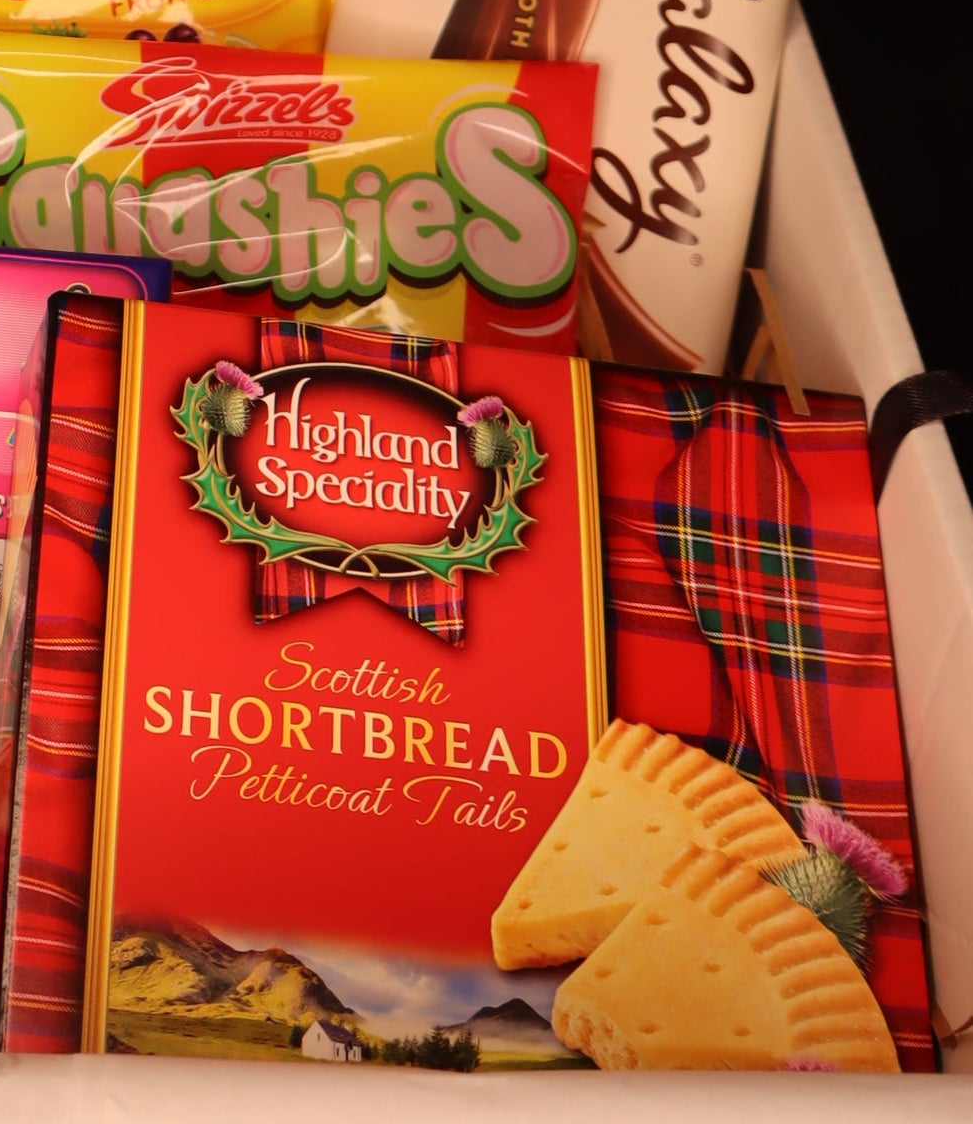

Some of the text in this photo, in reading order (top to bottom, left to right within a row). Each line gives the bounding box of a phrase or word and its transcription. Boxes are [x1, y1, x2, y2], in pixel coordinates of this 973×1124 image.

[100, 57, 355, 148] Swizzels
[237, 128, 337, 139] Loved since 1928
[260, 377, 460, 471] Highland
[255, 456, 471, 529] Speciality
[264, 641, 451, 706] Scottish
[143, 685, 568, 780] SHORTBREAD
[189, 744, 529, 833] Petticoat Tails
